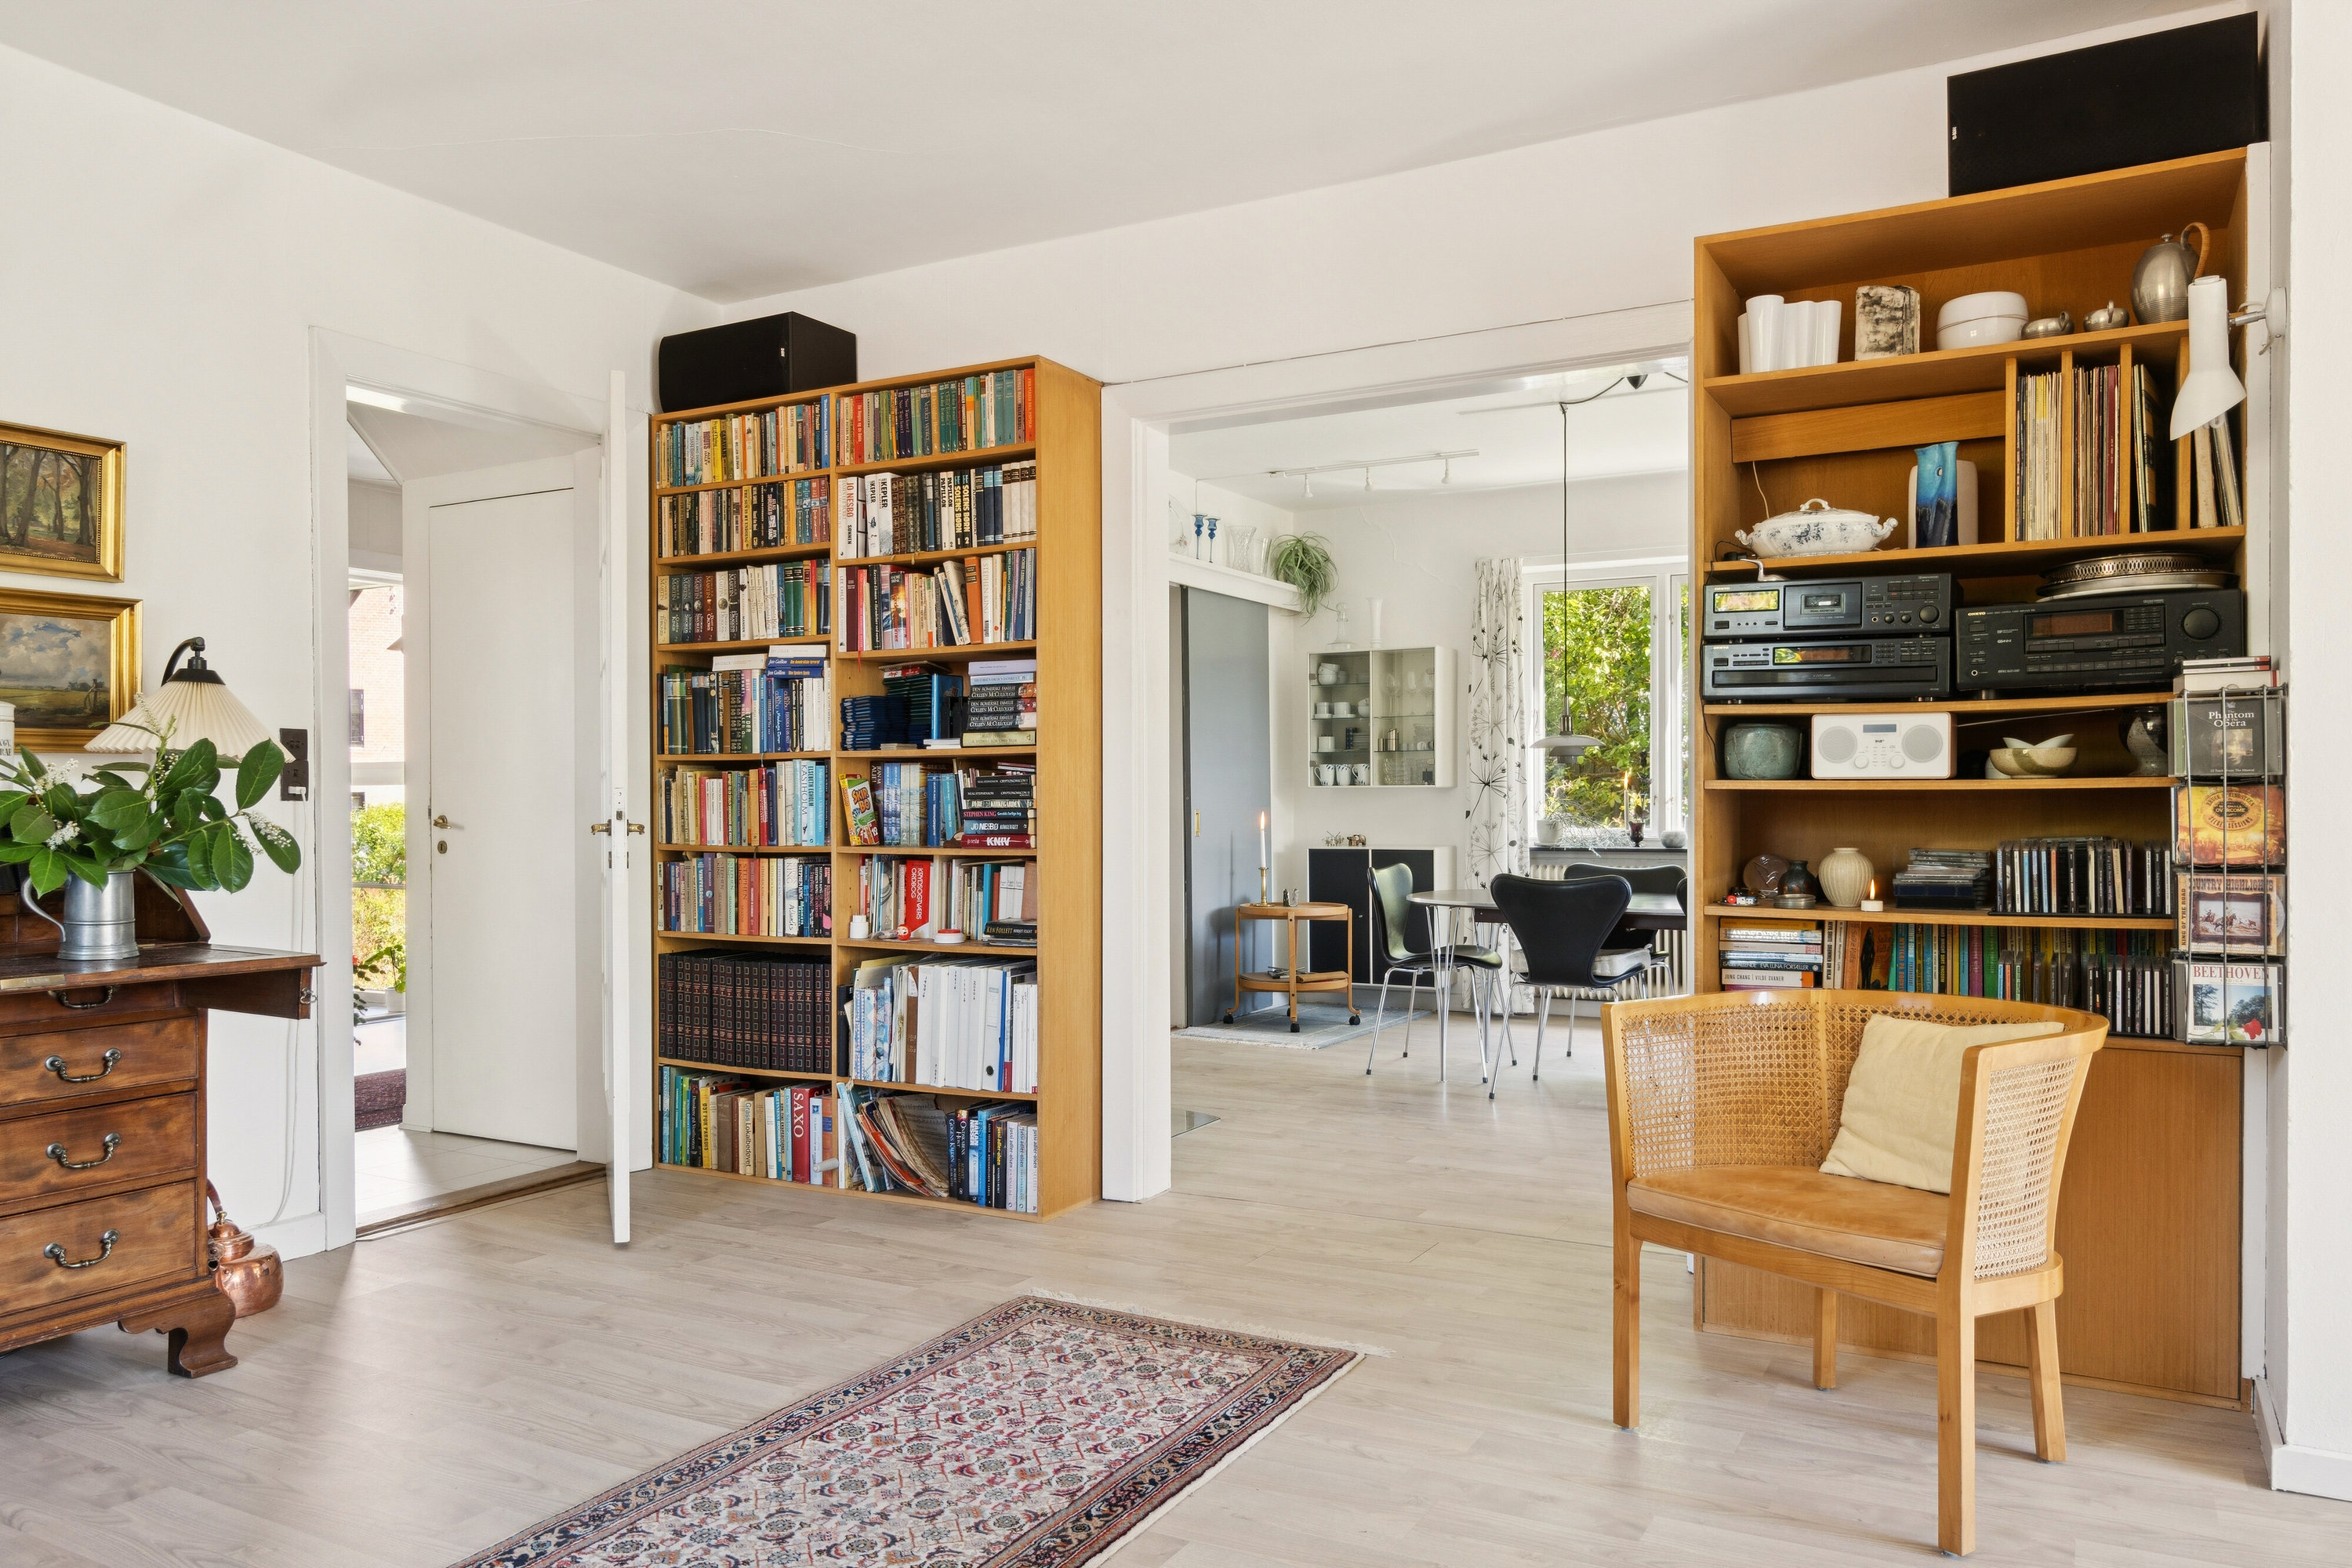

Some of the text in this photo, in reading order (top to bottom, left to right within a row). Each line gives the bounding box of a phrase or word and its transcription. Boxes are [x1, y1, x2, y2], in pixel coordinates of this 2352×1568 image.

[846, 492, 855, 517] NESBØ
[858, 799, 871, 814] BO
[2226, 879, 2274, 892] HIGHLIGHS
[2193, 965, 2270, 979] BEETHOVEN
[793, 1092, 804, 1138] SAXO
